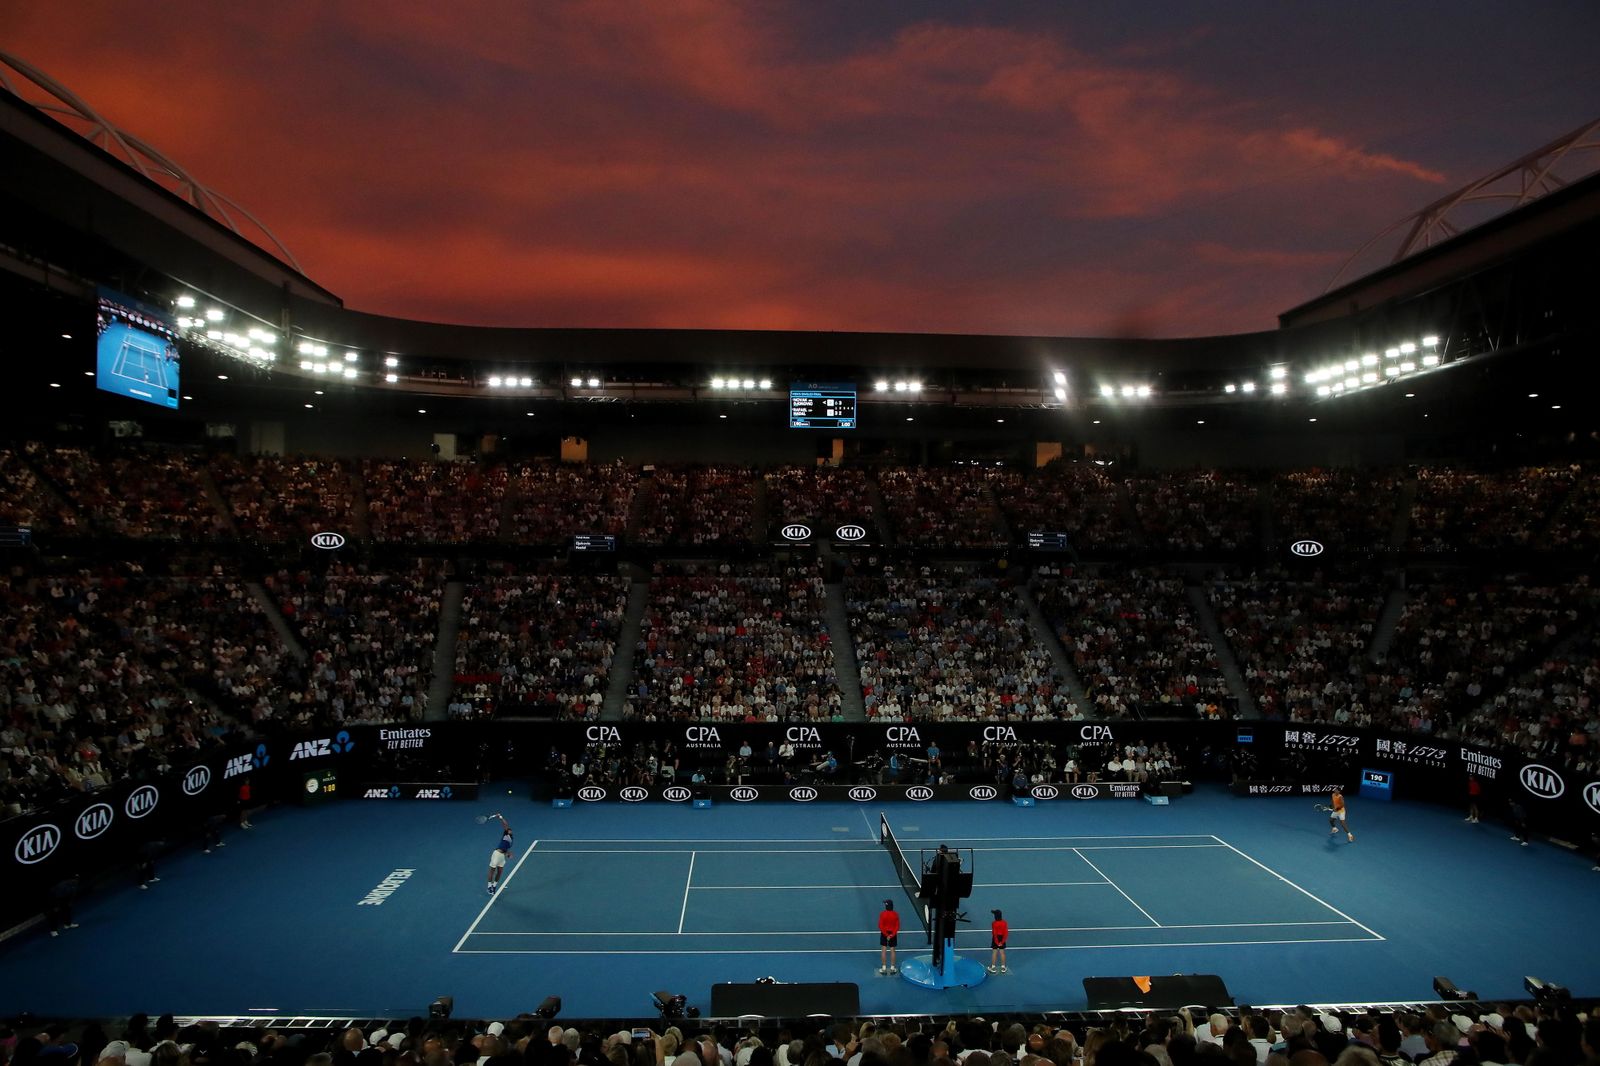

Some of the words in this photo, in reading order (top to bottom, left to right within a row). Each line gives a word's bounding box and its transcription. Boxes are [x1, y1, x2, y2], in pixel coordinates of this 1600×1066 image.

[787, 528, 807, 537] KIA
[842, 529, 861, 537] KIA
[317, 536, 339, 546] KIA
[1297, 544, 1318, 553] KIA
[380, 728, 431, 740] Emirates
[586, 726, 621, 741] CPA
[686, 727, 720, 741] CPA
[786, 727, 821, 742] CPA
[886, 727, 920, 741] CPA
[983, 726, 1017, 741] CPA
[1080, 725, 1114, 740] CPA
[289, 738, 331, 760] ANZ
[387, 740, 399, 750] FLY
[400, 739, 424, 749] BETTER
[1461, 747, 1502, 769] Emirates
[224, 753, 253, 779] ANZ
[187, 771, 208, 790] KIA
[1527, 769, 1557, 794] KIA
[363, 788, 389, 798] ANZ
[911, 789, 929, 797] KIA
[974, 789, 992, 797] KIA
[1036, 788, 1053, 796] KIA
[1076, 787, 1094, 796] KIA
[1109, 784, 1140, 792] Emirates
[415, 789, 440, 798] ANZ
[583, 789, 601, 798] KIA
[625, 789, 643, 798] KIA
[668, 790, 686, 798] KIA
[735, 790, 754, 798] KIA
[795, 789, 813, 798] KIA
[853, 789, 872, 798] KIA
[131, 790, 155, 815] KIA
[82, 809, 108, 834] KIA
[24, 830, 54, 859] KIA
